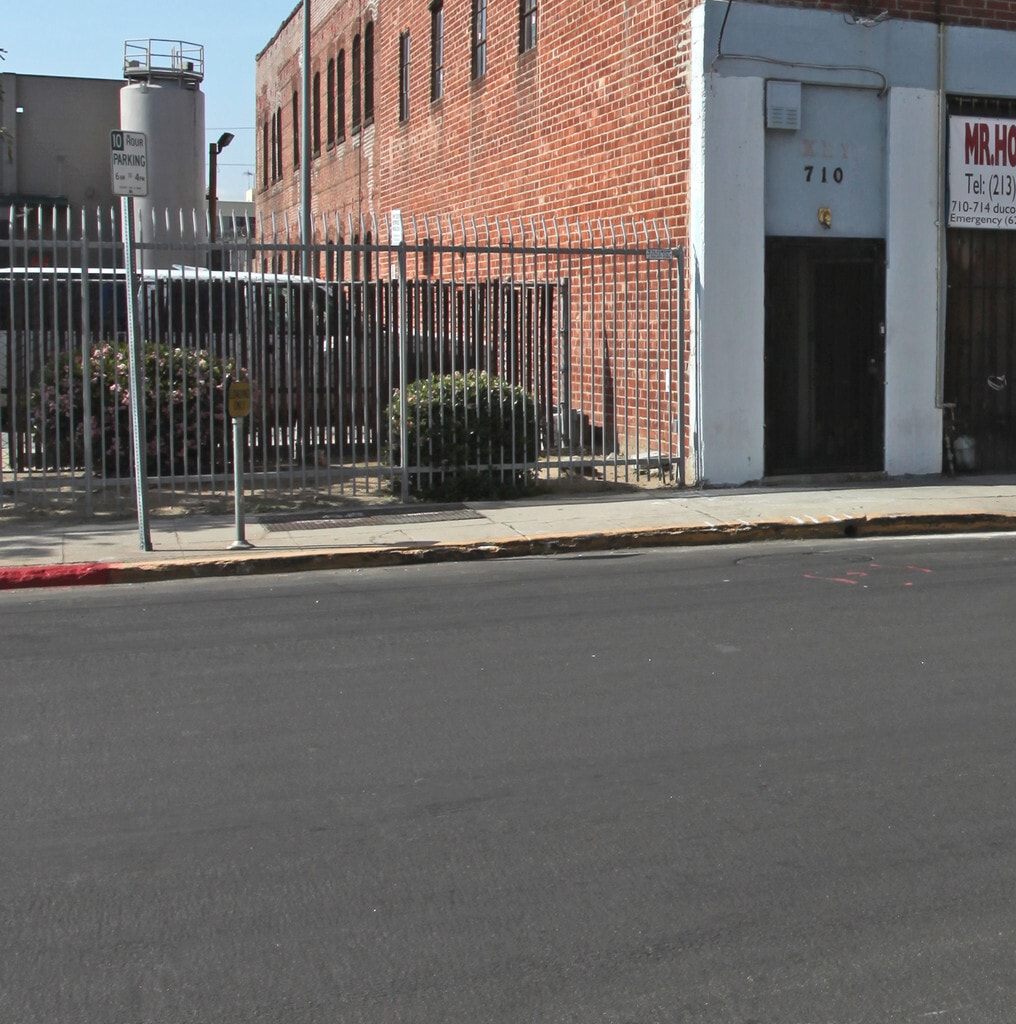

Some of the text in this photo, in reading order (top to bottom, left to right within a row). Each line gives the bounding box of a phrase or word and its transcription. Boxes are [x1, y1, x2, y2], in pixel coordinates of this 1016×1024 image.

[112, 133, 122, 148] 10
[113, 154, 145, 167] PARKING
[804, 165, 844, 184] 710
[965, 173, 985, 195] Tel:
[988, 174, 1016, 202] (213)
[951, 200, 991, 214] 710-714
[950, 213, 1002, 226] Emergency
